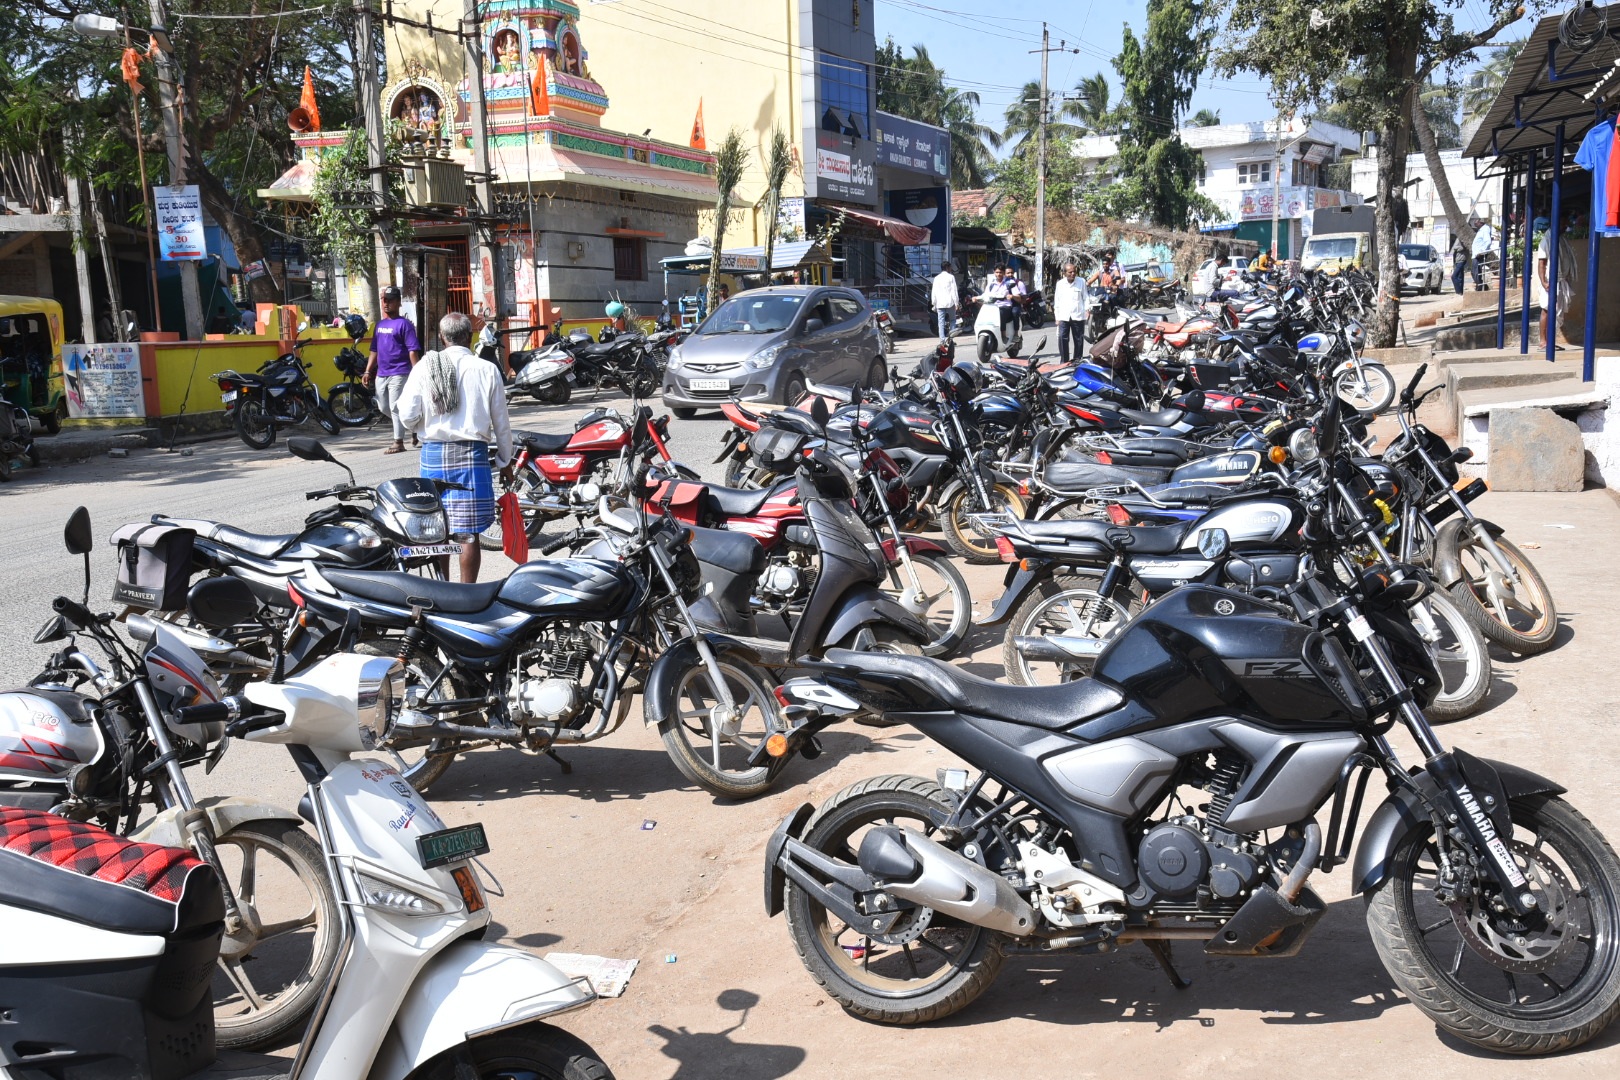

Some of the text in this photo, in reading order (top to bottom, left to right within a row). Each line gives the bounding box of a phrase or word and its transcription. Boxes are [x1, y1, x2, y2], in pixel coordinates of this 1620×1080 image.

[171, 200, 199, 210] ಕುಡಿಯುವ
[174, 235, 188, 243] 20
[1216, 461, 1249, 471] YAMAHA
[128, 590, 155, 600] PRAVEEN
[32, 710, 60, 727] ero
[1456, 784, 1496, 842] YAMAHA
